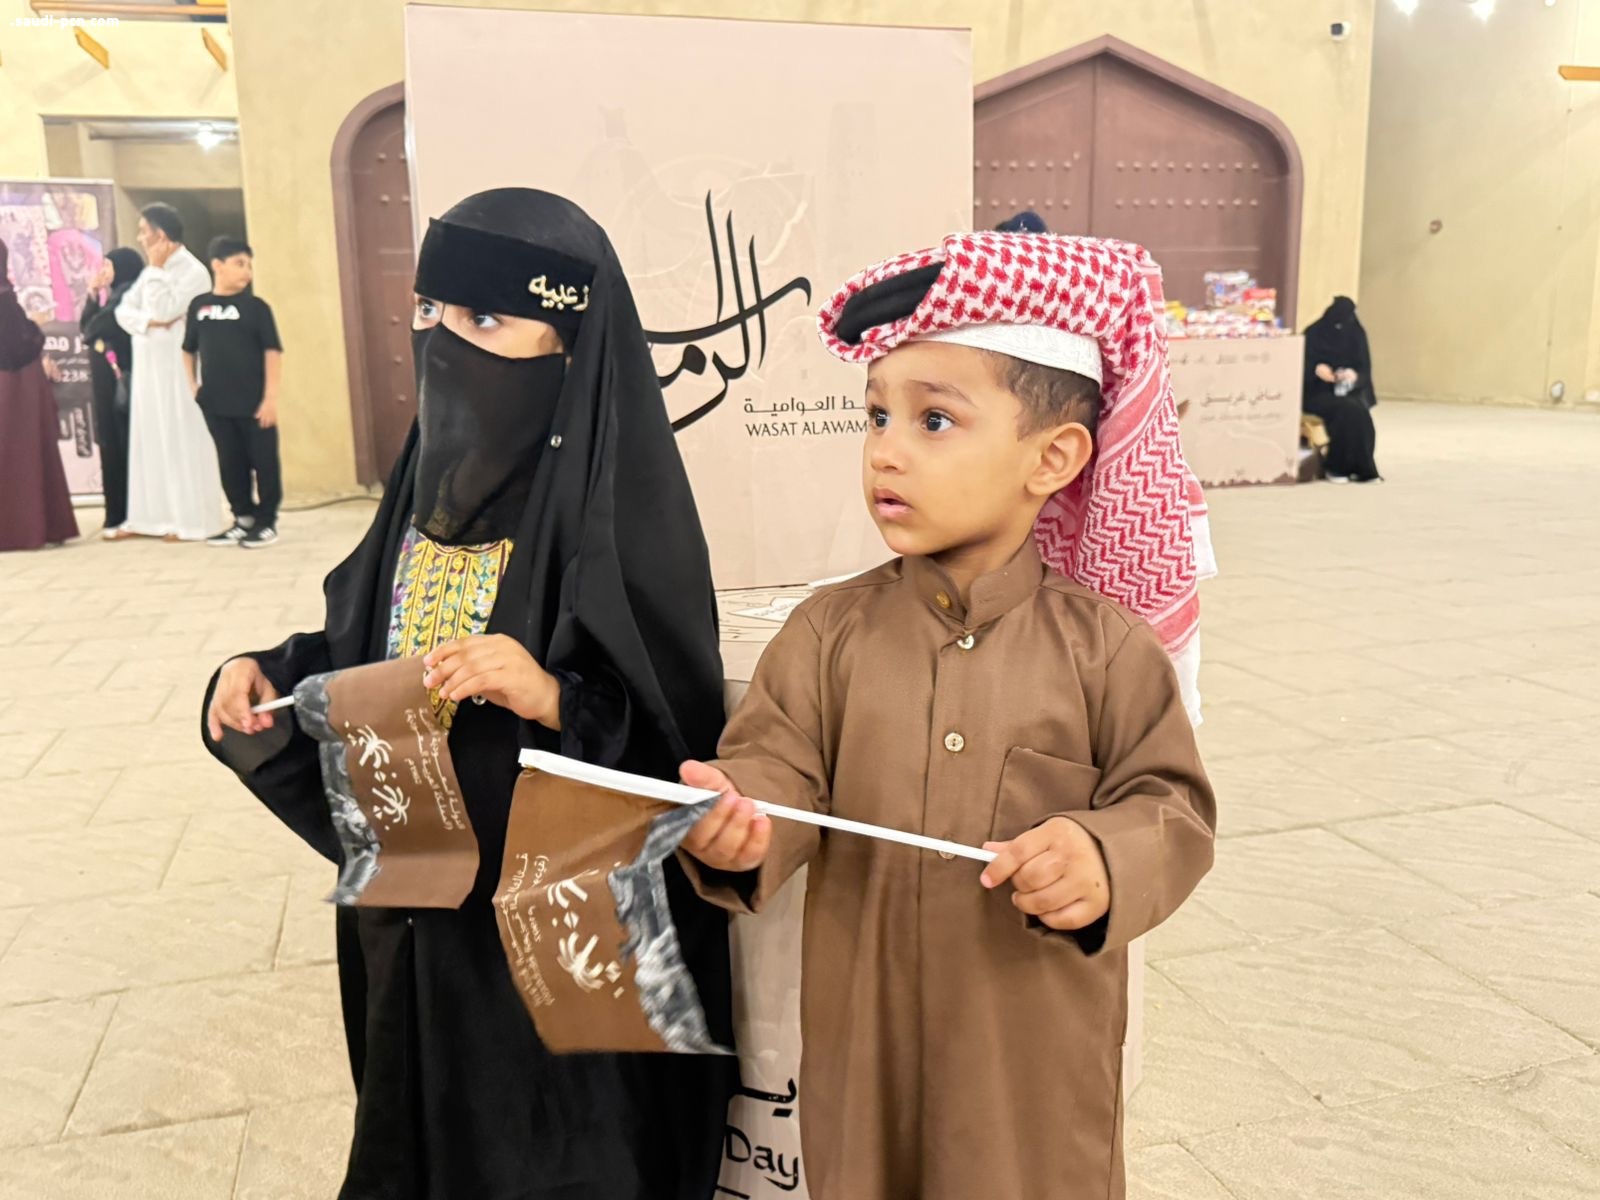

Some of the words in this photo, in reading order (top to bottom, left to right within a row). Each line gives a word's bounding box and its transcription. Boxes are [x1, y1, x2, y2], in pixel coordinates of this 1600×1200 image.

[197, 304, 240, 321] FILA
[743, 395, 835, 417] العوامية
[745, 421, 798, 437] WASAT
[801, 420, 867, 435] ALAWAM
[725, 1124, 798, 1191] Day
